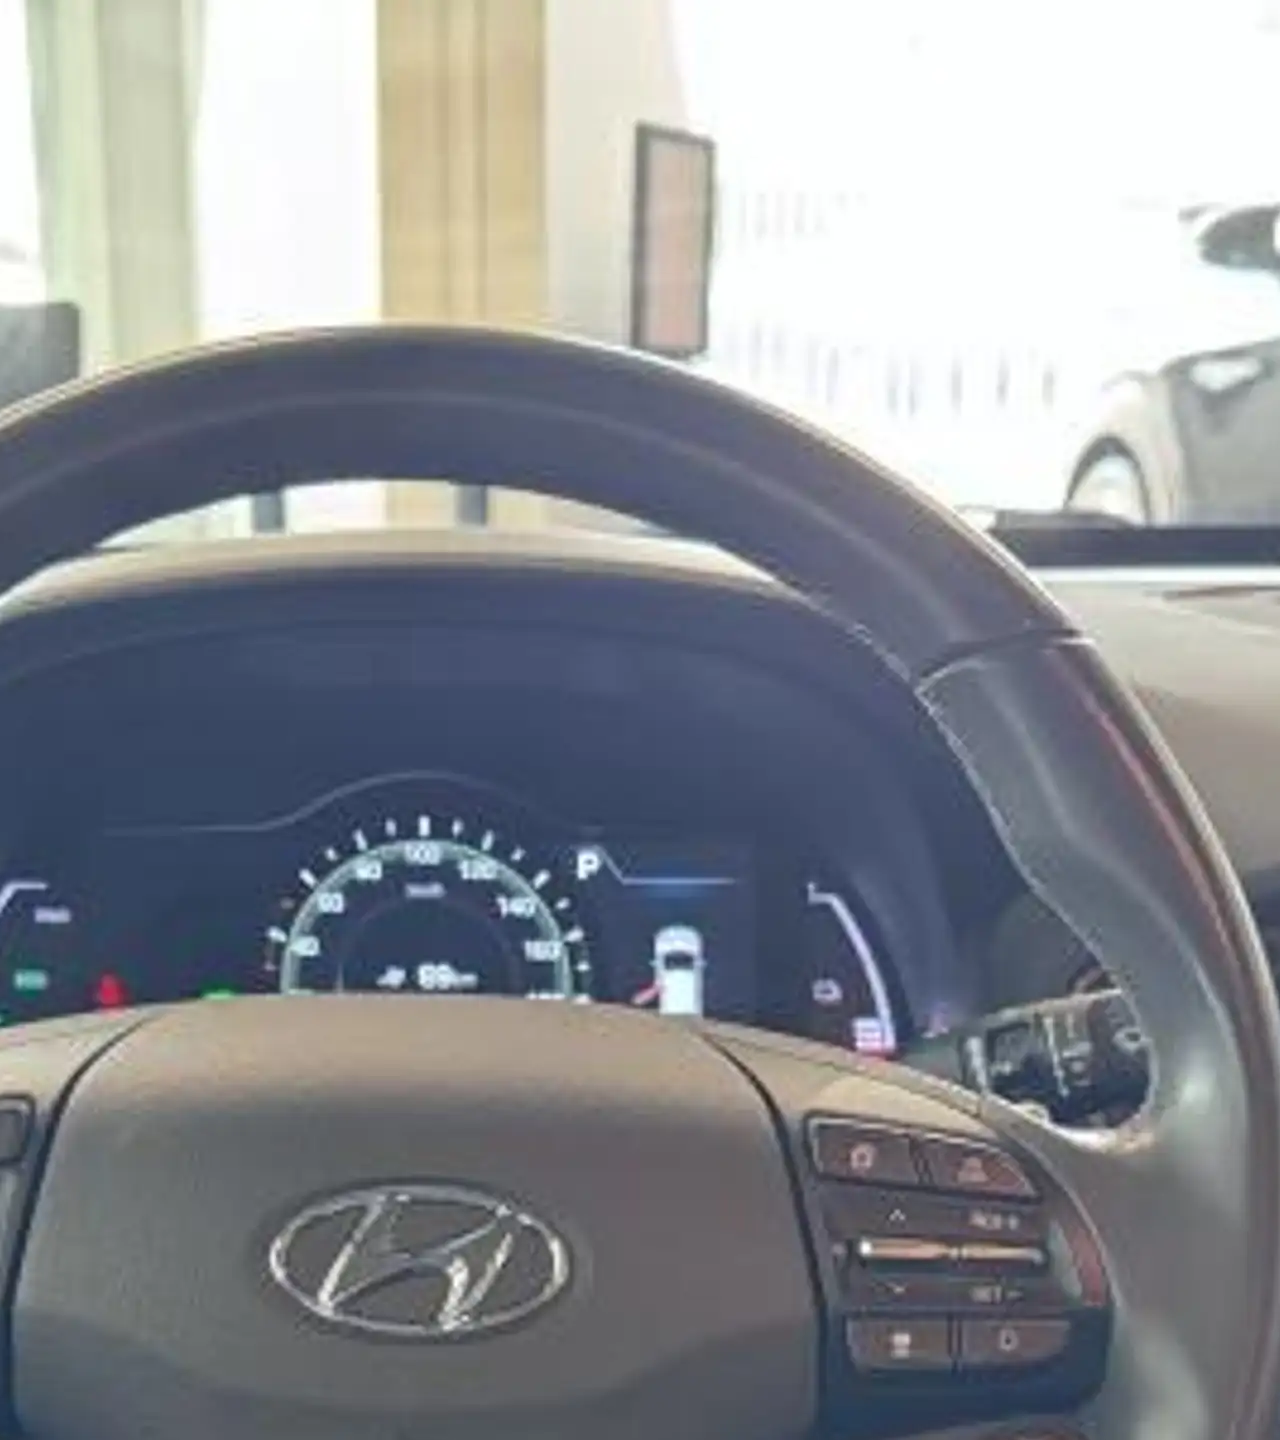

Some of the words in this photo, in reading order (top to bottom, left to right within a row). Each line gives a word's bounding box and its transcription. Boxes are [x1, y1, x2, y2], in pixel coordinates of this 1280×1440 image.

[404, 843, 442, 865] 100
[576, 851, 600, 879] P
[458, 859, 498, 880] 120
[497, 895, 536, 917] 140
